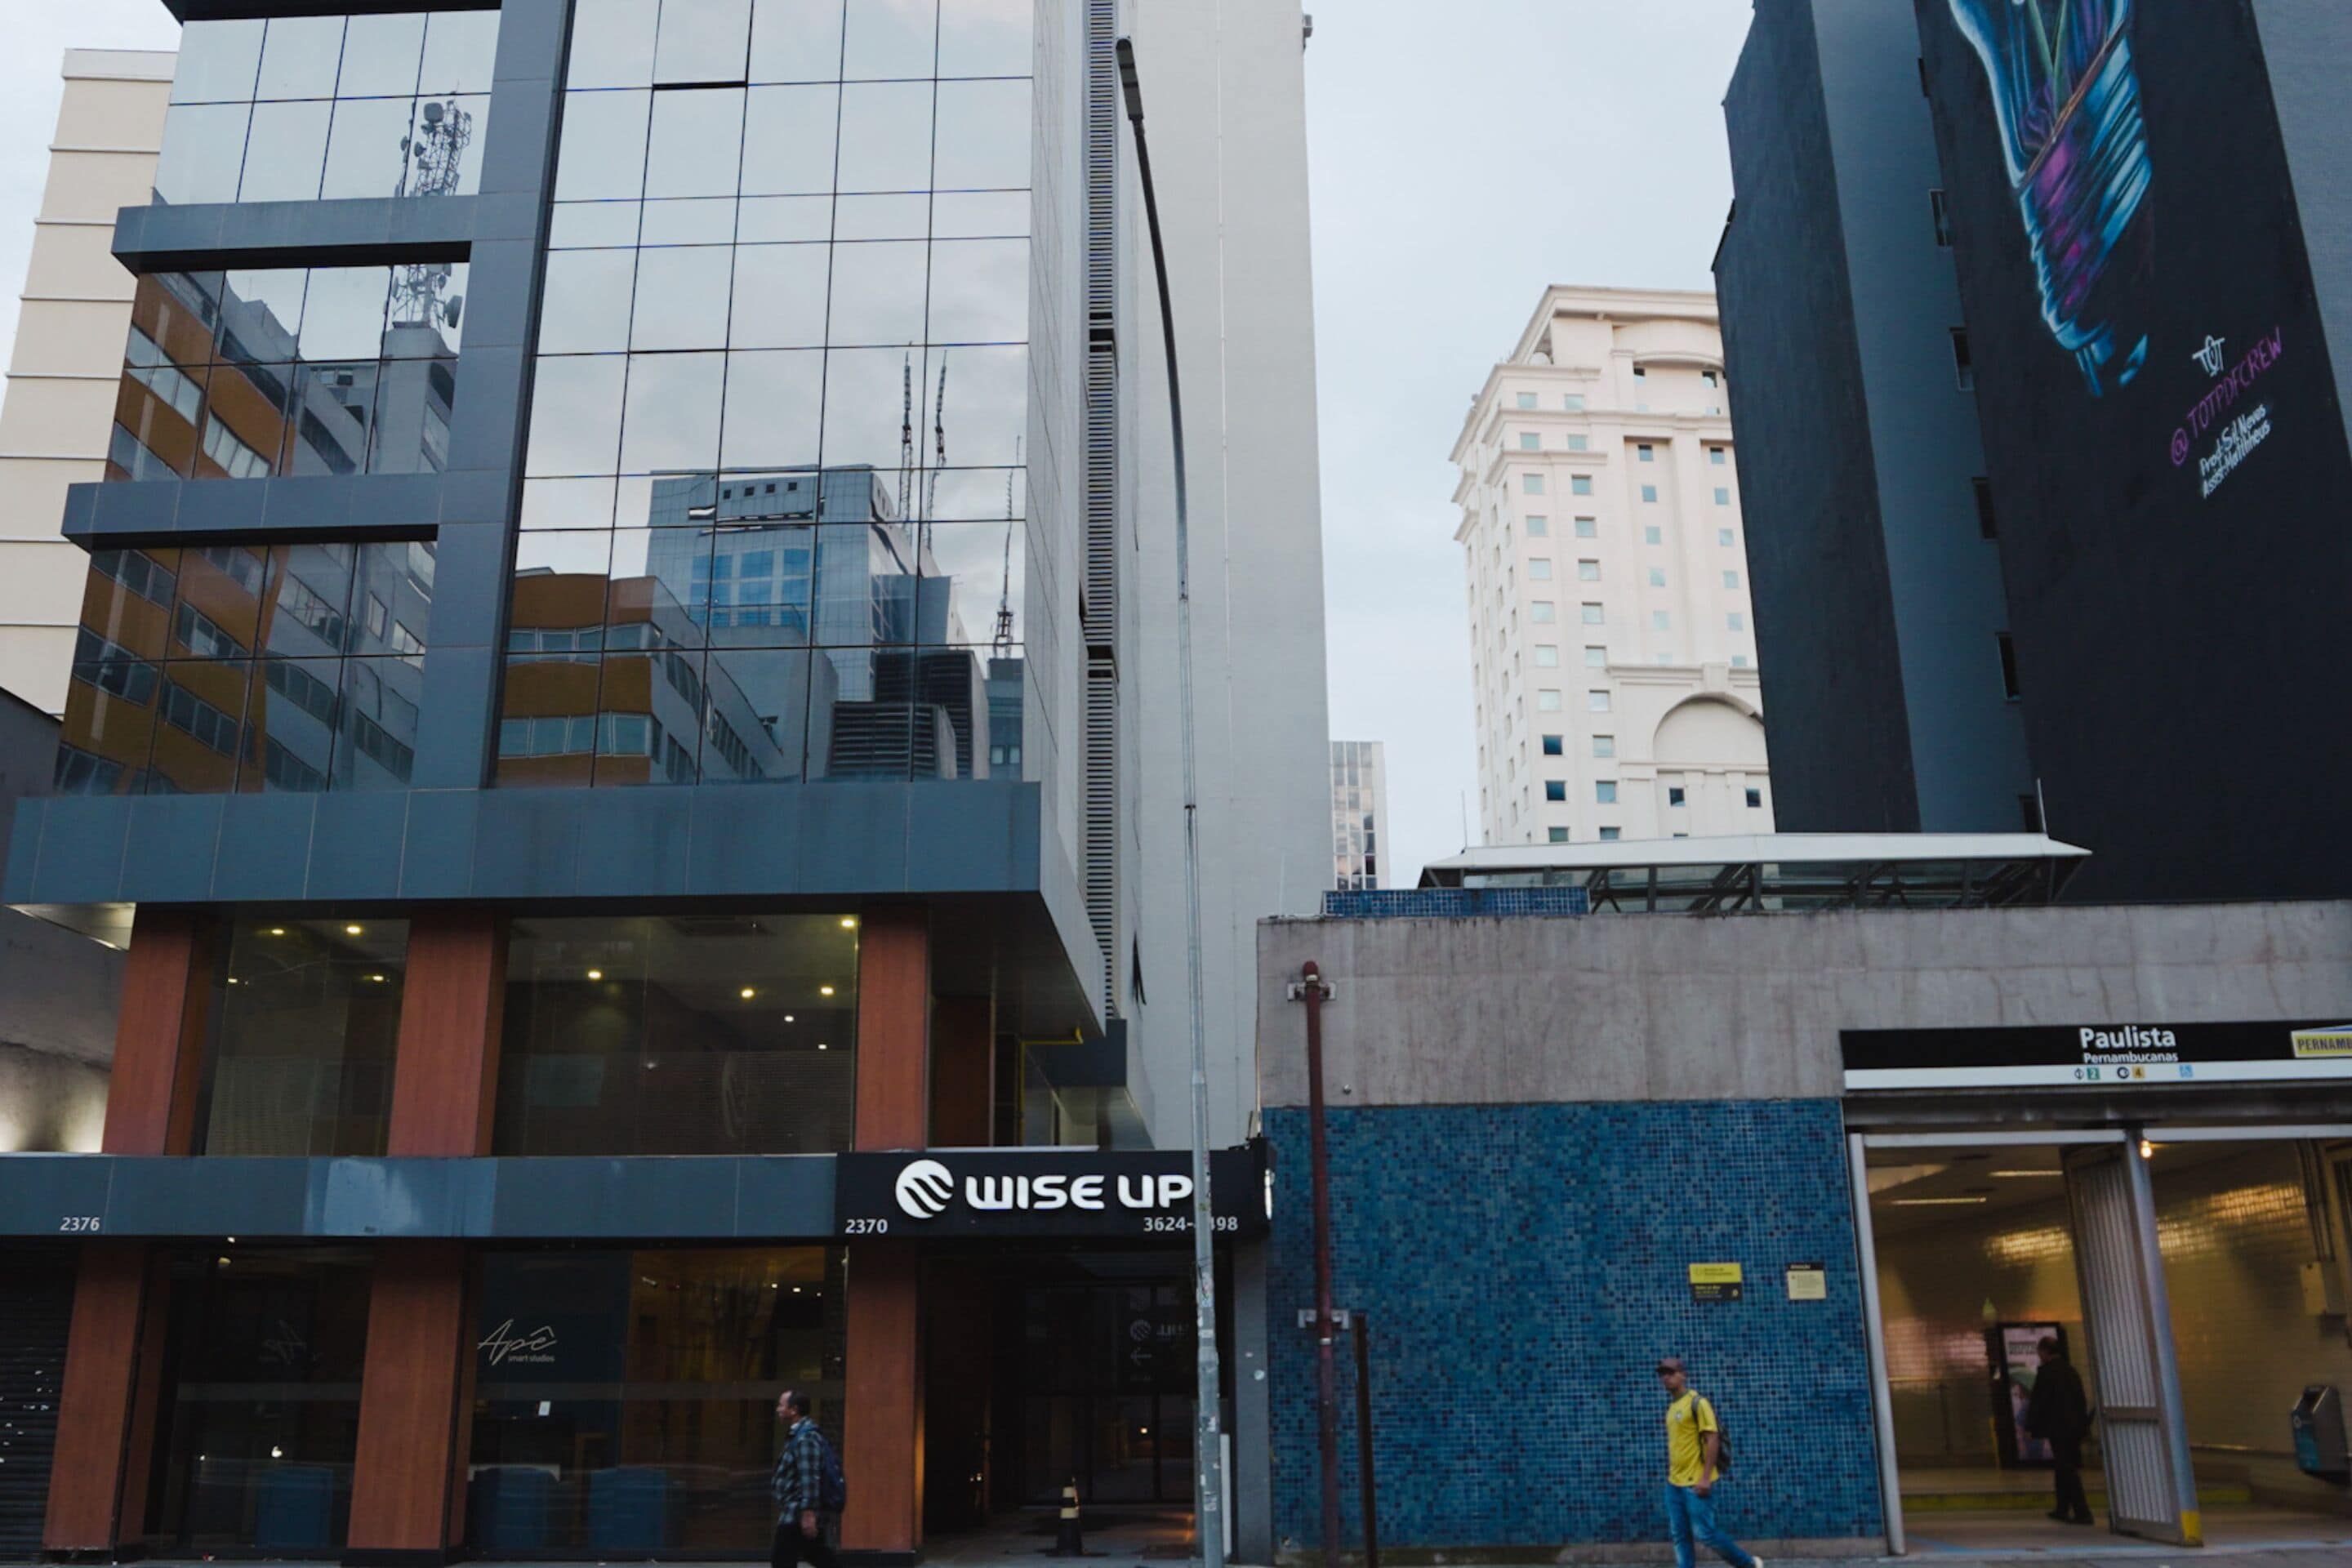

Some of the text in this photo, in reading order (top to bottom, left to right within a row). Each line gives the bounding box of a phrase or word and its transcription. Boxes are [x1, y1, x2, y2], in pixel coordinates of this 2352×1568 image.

[2079, 1026, 2176, 1049] Paulista
[2083, 1052, 2179, 1064] Pernambucanas
[965, 1174, 1193, 1210] WISE UP
[60, 1217, 100, 1232] 2376
[844, 1218, 889, 1234] 2370
[477, 1318, 558, 1366] Apê
